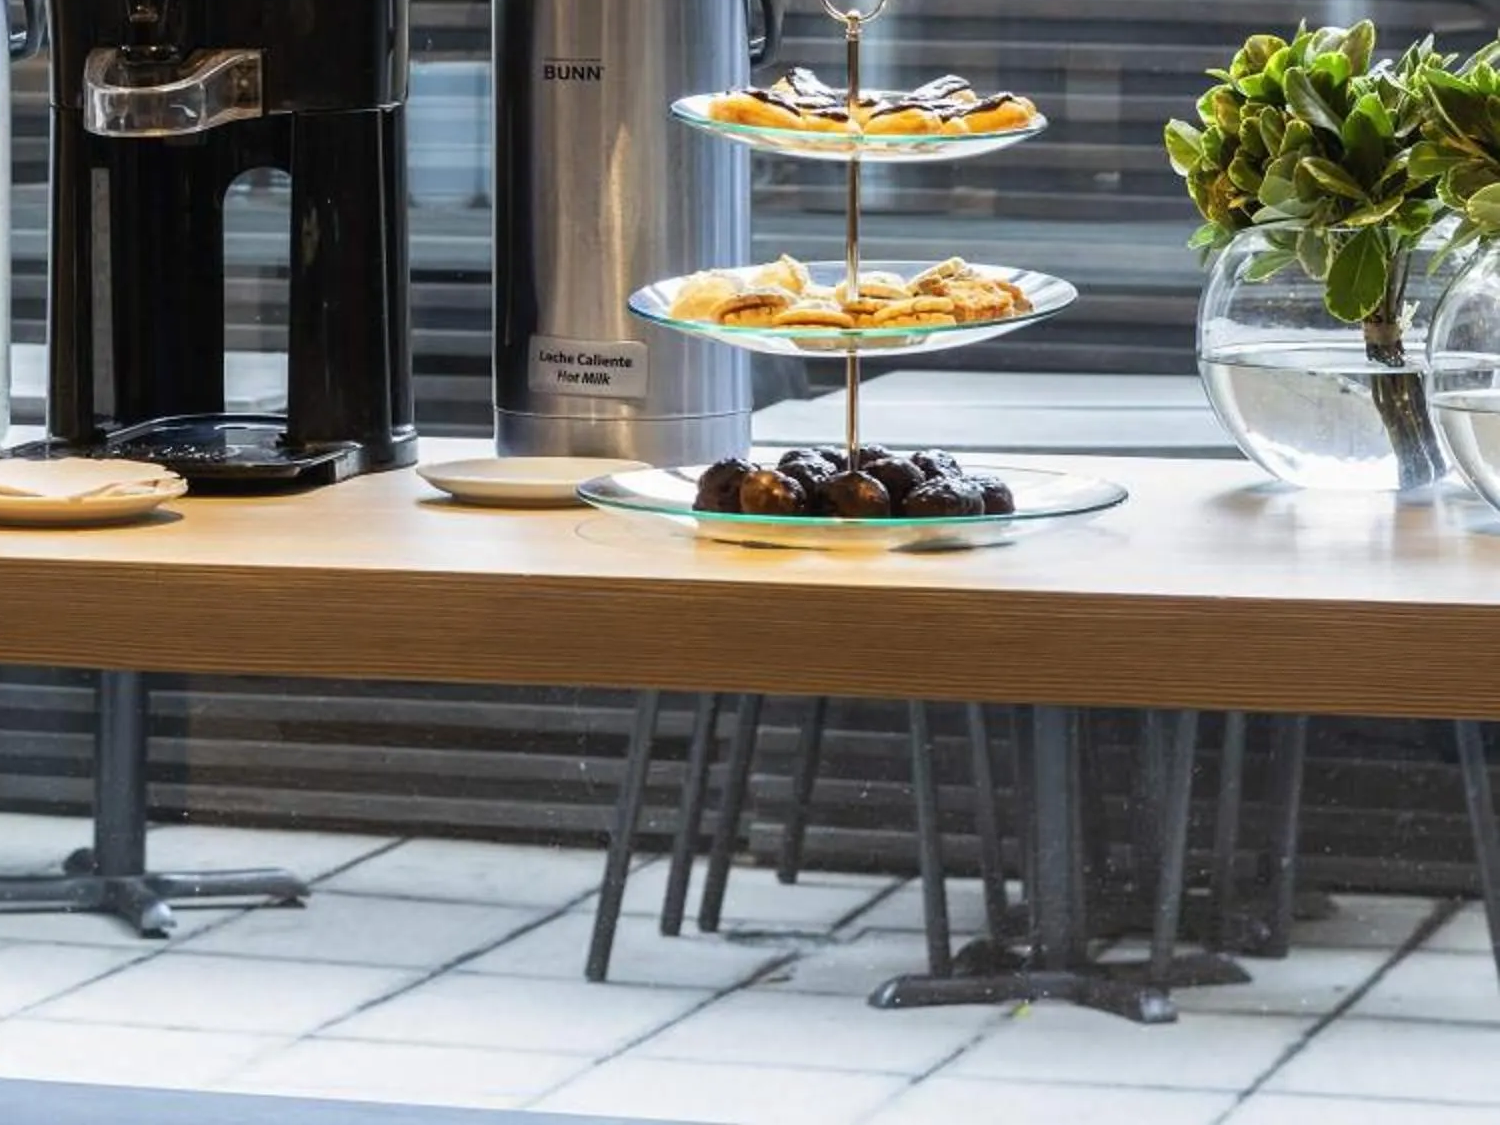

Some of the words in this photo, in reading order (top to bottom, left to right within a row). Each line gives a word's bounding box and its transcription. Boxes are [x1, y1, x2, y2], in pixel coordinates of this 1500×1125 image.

[544, 64, 601, 81] BUNN
[539, 350, 575, 365] Leche
[577, 353, 633, 368] Caliente
[556, 370, 581, 384] Hot
[582, 372, 612, 387] Milk
